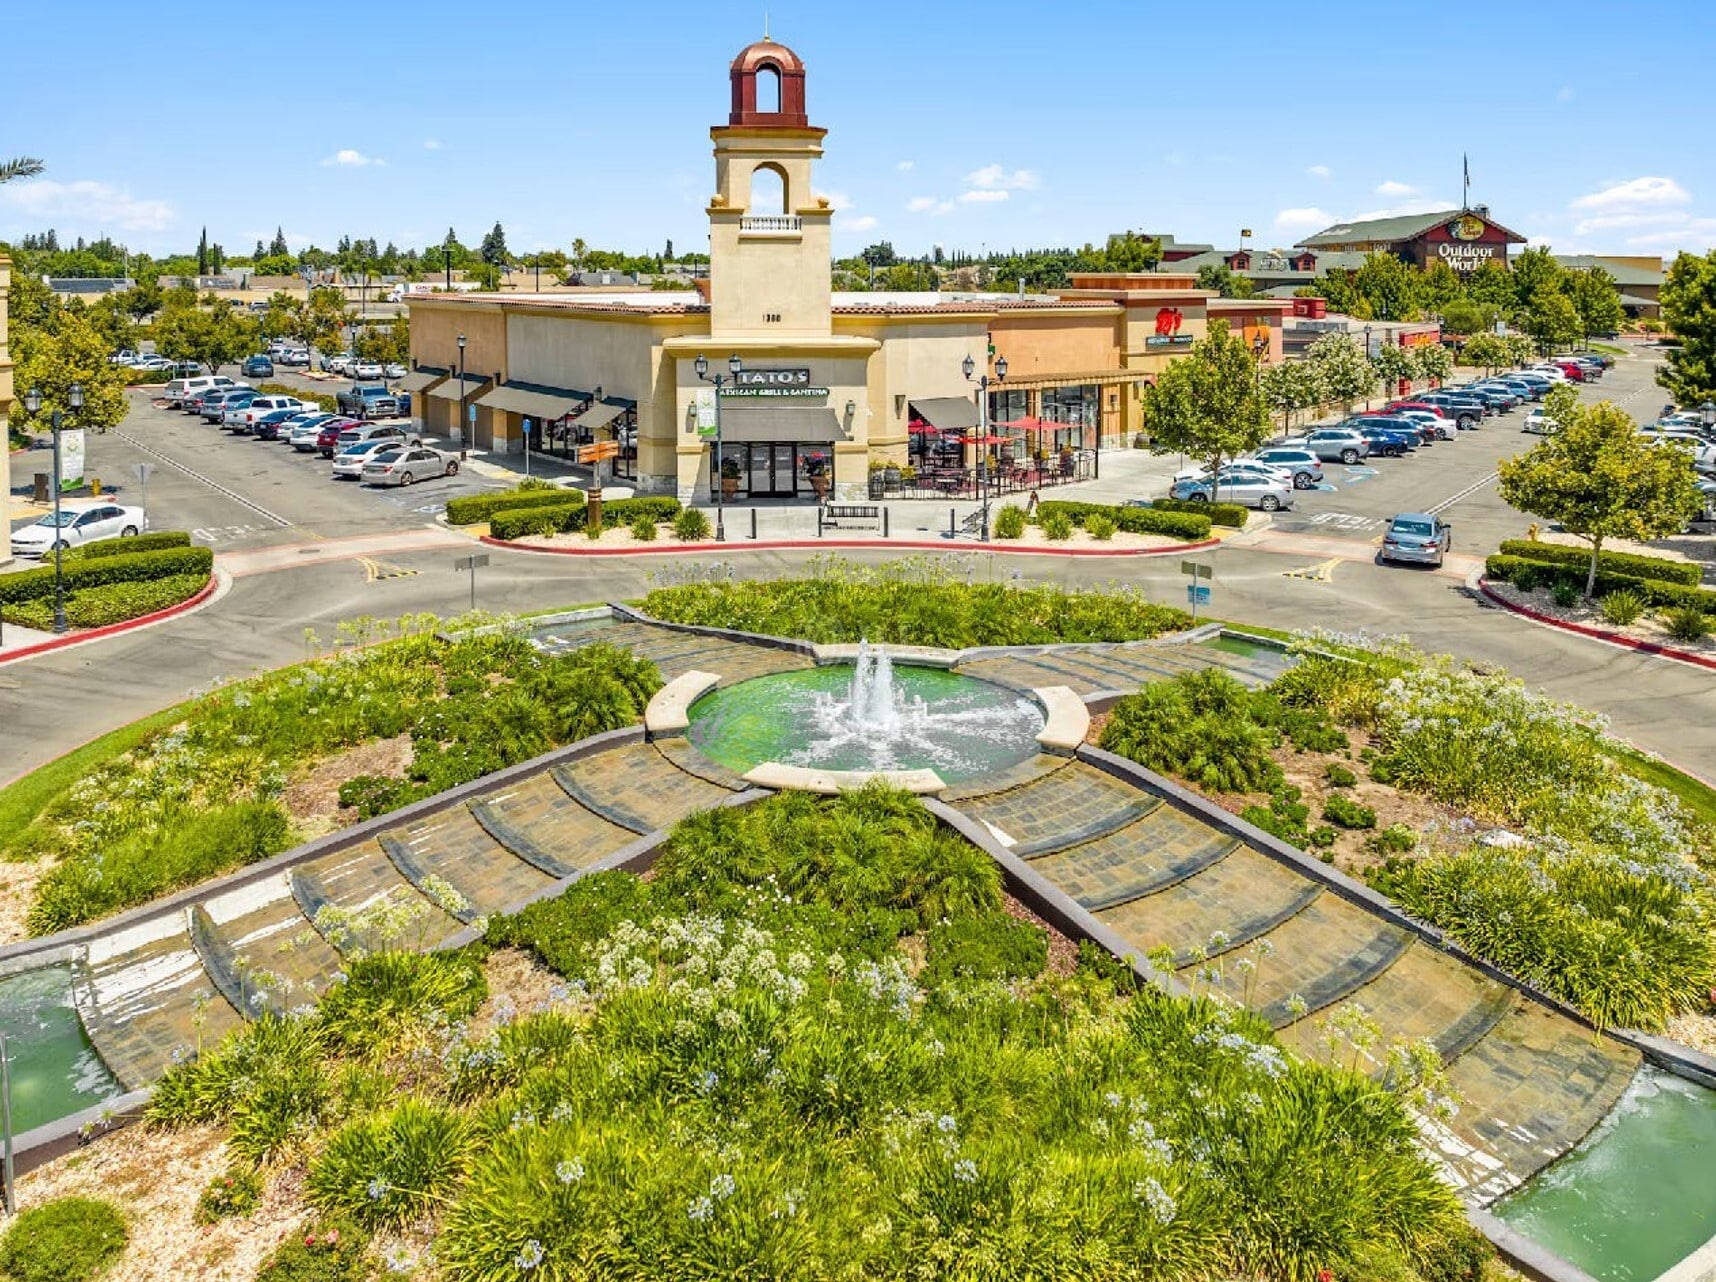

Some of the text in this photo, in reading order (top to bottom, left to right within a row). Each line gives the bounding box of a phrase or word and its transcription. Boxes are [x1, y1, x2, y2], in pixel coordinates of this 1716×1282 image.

[1438, 243, 1494, 257] Outdoor
[739, 371, 808, 384] TATO'S
[790, 388, 828, 396] CANTINA
